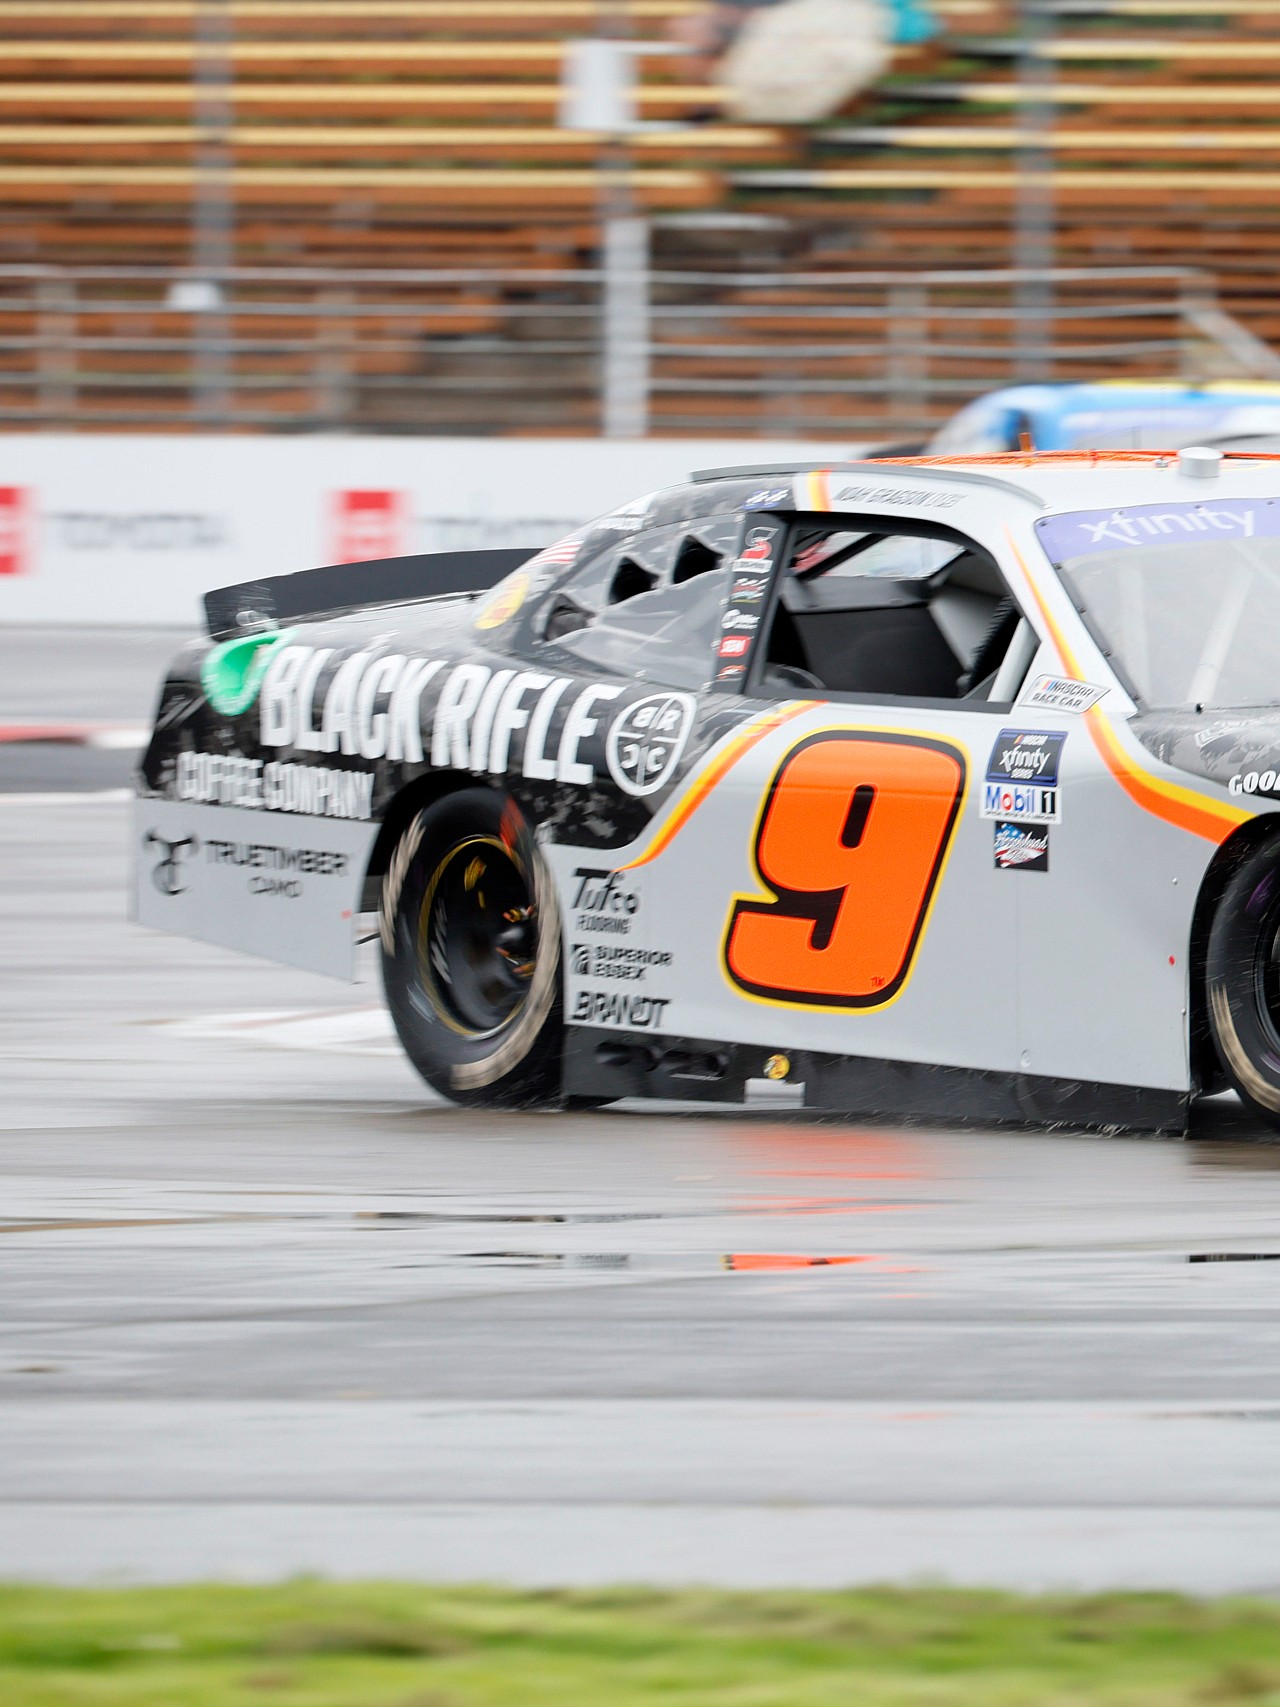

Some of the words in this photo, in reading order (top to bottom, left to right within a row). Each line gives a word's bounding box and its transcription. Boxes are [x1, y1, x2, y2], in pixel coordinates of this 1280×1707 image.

[1077, 506, 1255, 545] xfinity
[1032, 692, 1057, 704] RACE
[1060, 695, 1084, 709] CAR
[1047, 679, 1095, 698] NASCAR
[259, 645, 448, 764] BLACK
[431, 663, 626, 785] RIFLE
[999, 745, 1051, 775] xfinity
[176, 750, 264, 807] COFFEE
[263, 761, 375, 820] COMPANY
[985, 786, 1036, 813] Mobil
[1042, 791, 1056, 814] 1
[725, 727, 969, 1011] 9
[572, 867, 641, 914] Tufco
[596, 945, 674, 966] SUPERIOR
[570, 990, 671, 1028] BRANDT
